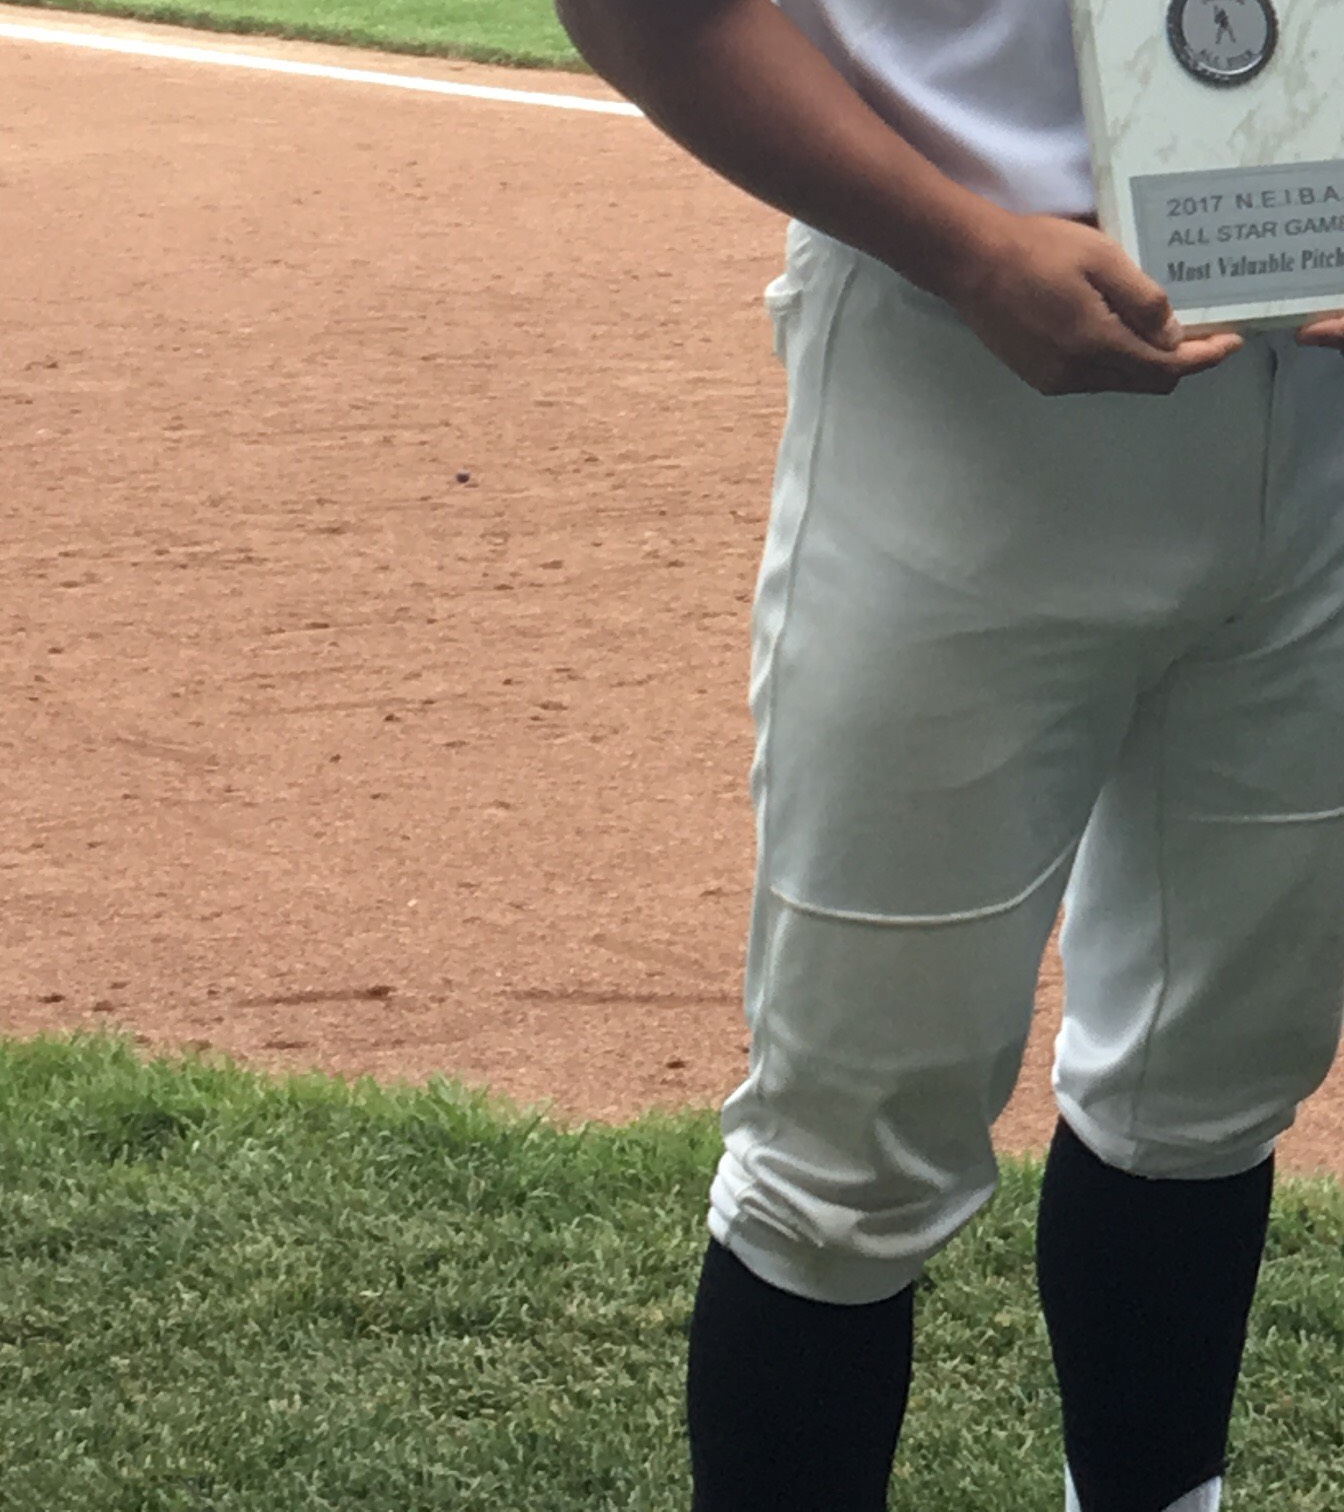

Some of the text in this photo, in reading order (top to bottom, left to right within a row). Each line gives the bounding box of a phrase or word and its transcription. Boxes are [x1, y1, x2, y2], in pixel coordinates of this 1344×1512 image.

[1166, 194, 1224, 218] 2017
[1167, 228, 1211, 248] ALL
[1217, 220, 1278, 243] STAR
[1166, 260, 1212, 283] Most
[1217, 251, 1297, 278] Valuable
